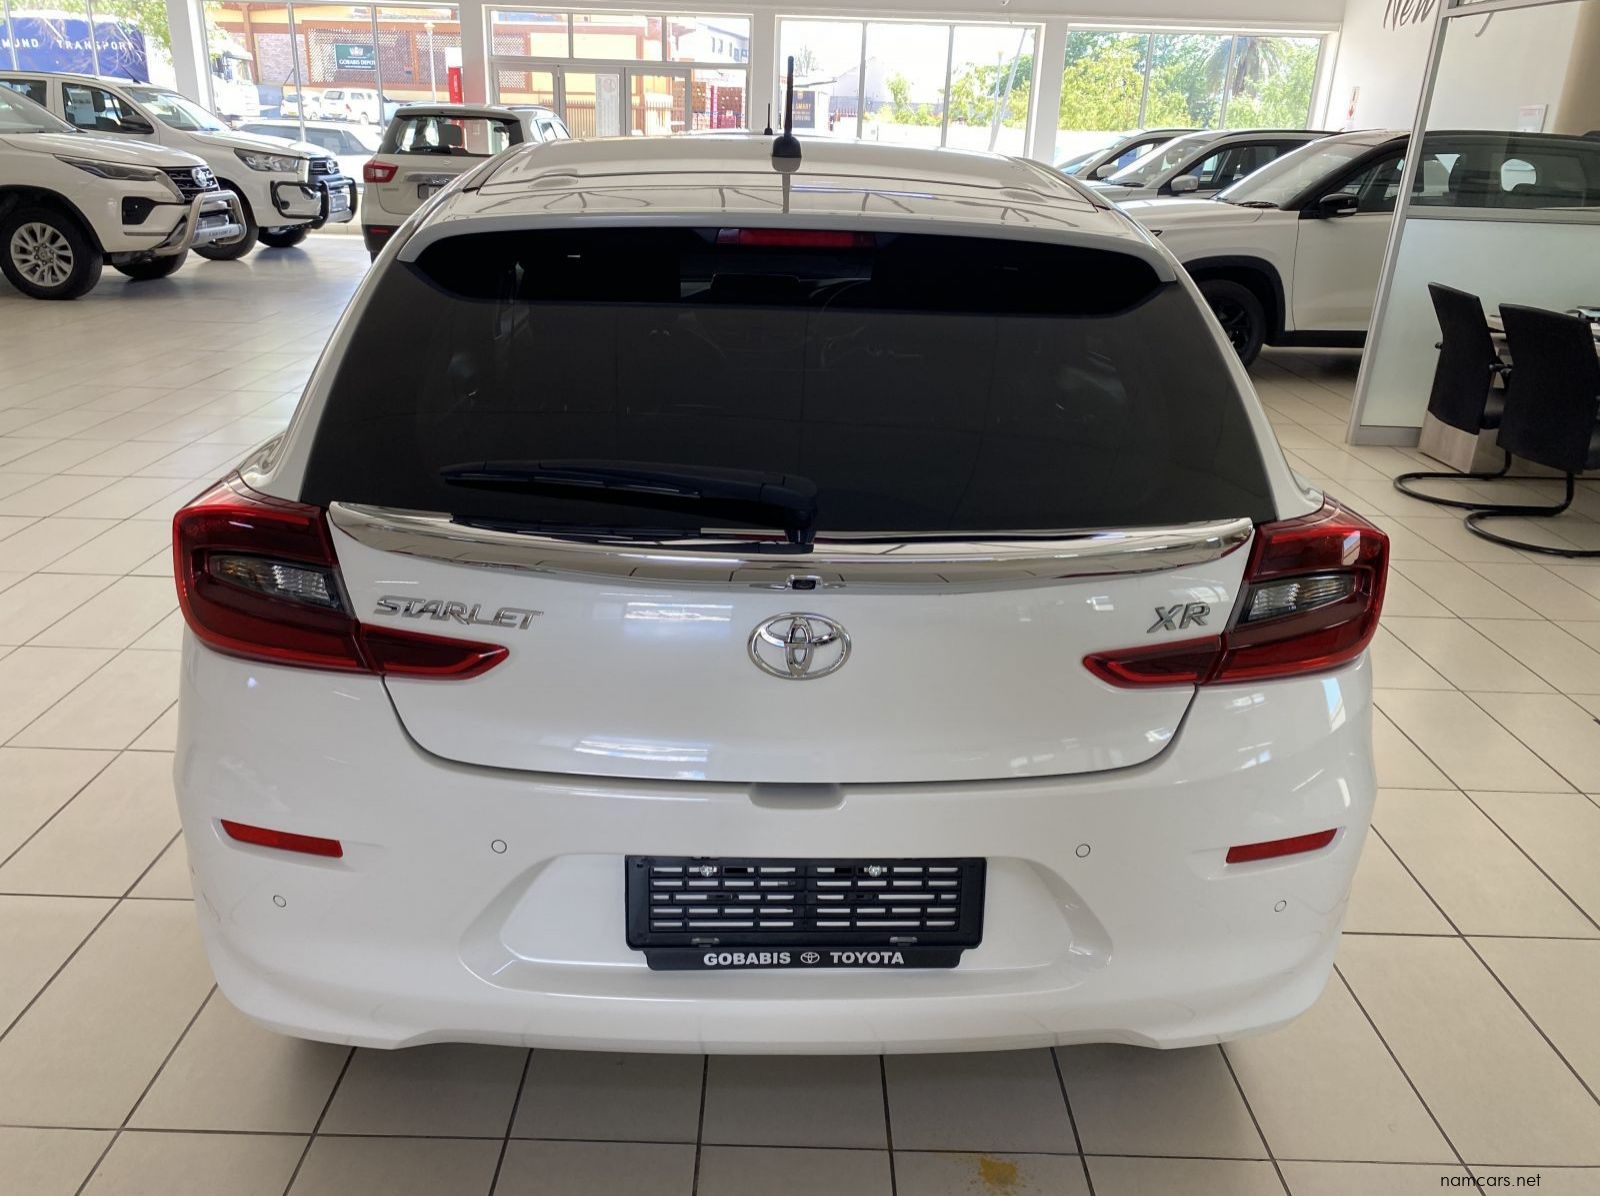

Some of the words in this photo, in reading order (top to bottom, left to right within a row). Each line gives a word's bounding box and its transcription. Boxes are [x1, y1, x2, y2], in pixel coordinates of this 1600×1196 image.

[374, 595, 544, 630] STARLET
[1146, 601, 1211, 634] XR
[703, 952, 791, 966] GOBABIS
[830, 951, 905, 965] TOYOTA
